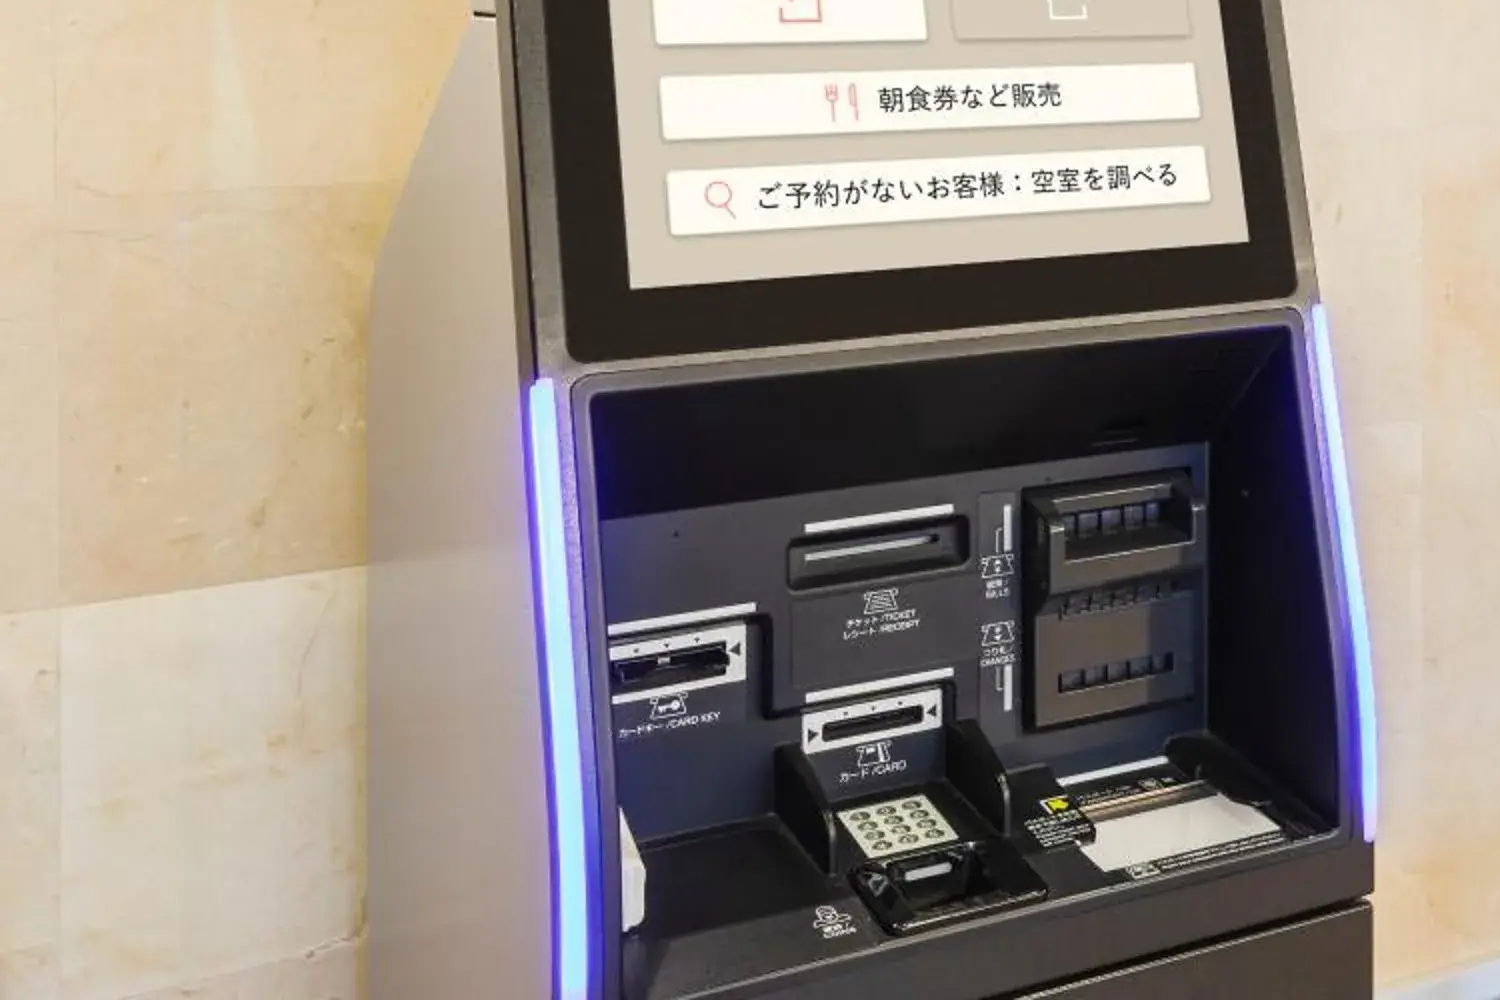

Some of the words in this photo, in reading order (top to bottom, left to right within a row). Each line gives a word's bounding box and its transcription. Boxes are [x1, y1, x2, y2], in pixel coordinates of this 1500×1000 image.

[877, 81, 1063, 113] 朝食券など販売
